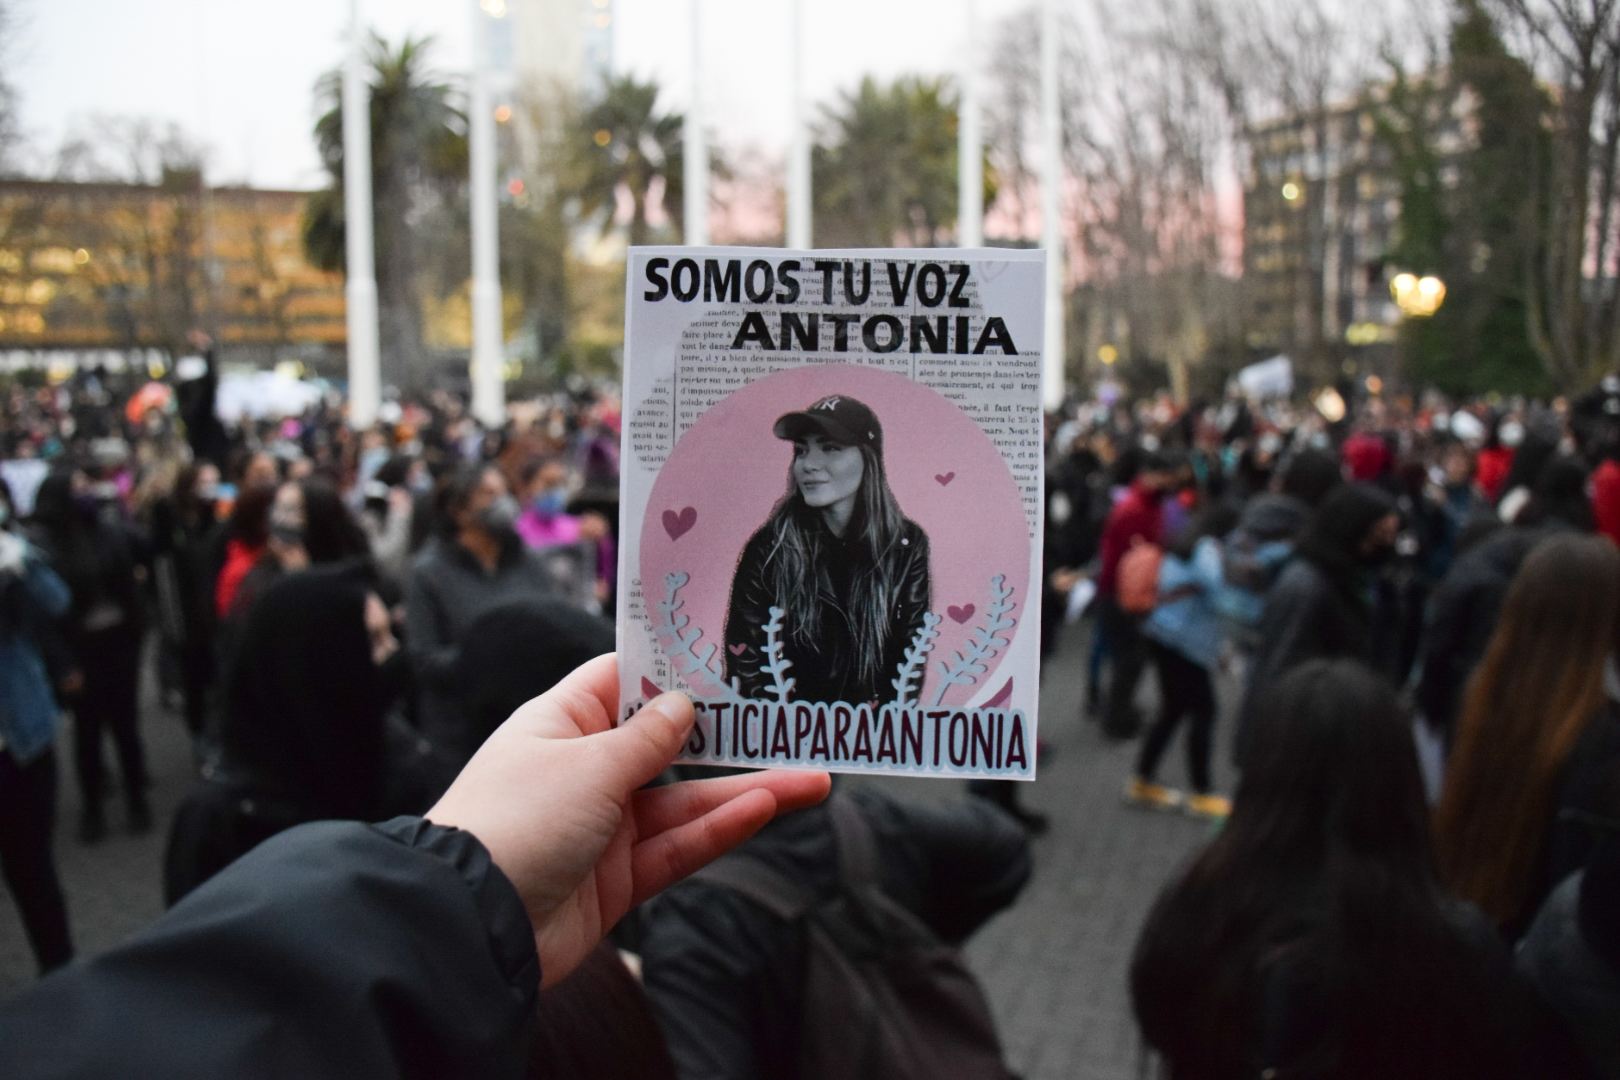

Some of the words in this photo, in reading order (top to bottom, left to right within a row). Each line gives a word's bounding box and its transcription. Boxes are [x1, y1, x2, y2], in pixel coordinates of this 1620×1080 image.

[644, 258, 801, 304] SOMOS
[815, 261, 871, 306] TU
[888, 263, 970, 308] VOZ
[731, 312, 1018, 355] ANTONIA
[625, 702, 1027, 770] STICIAPARAANTONIA
